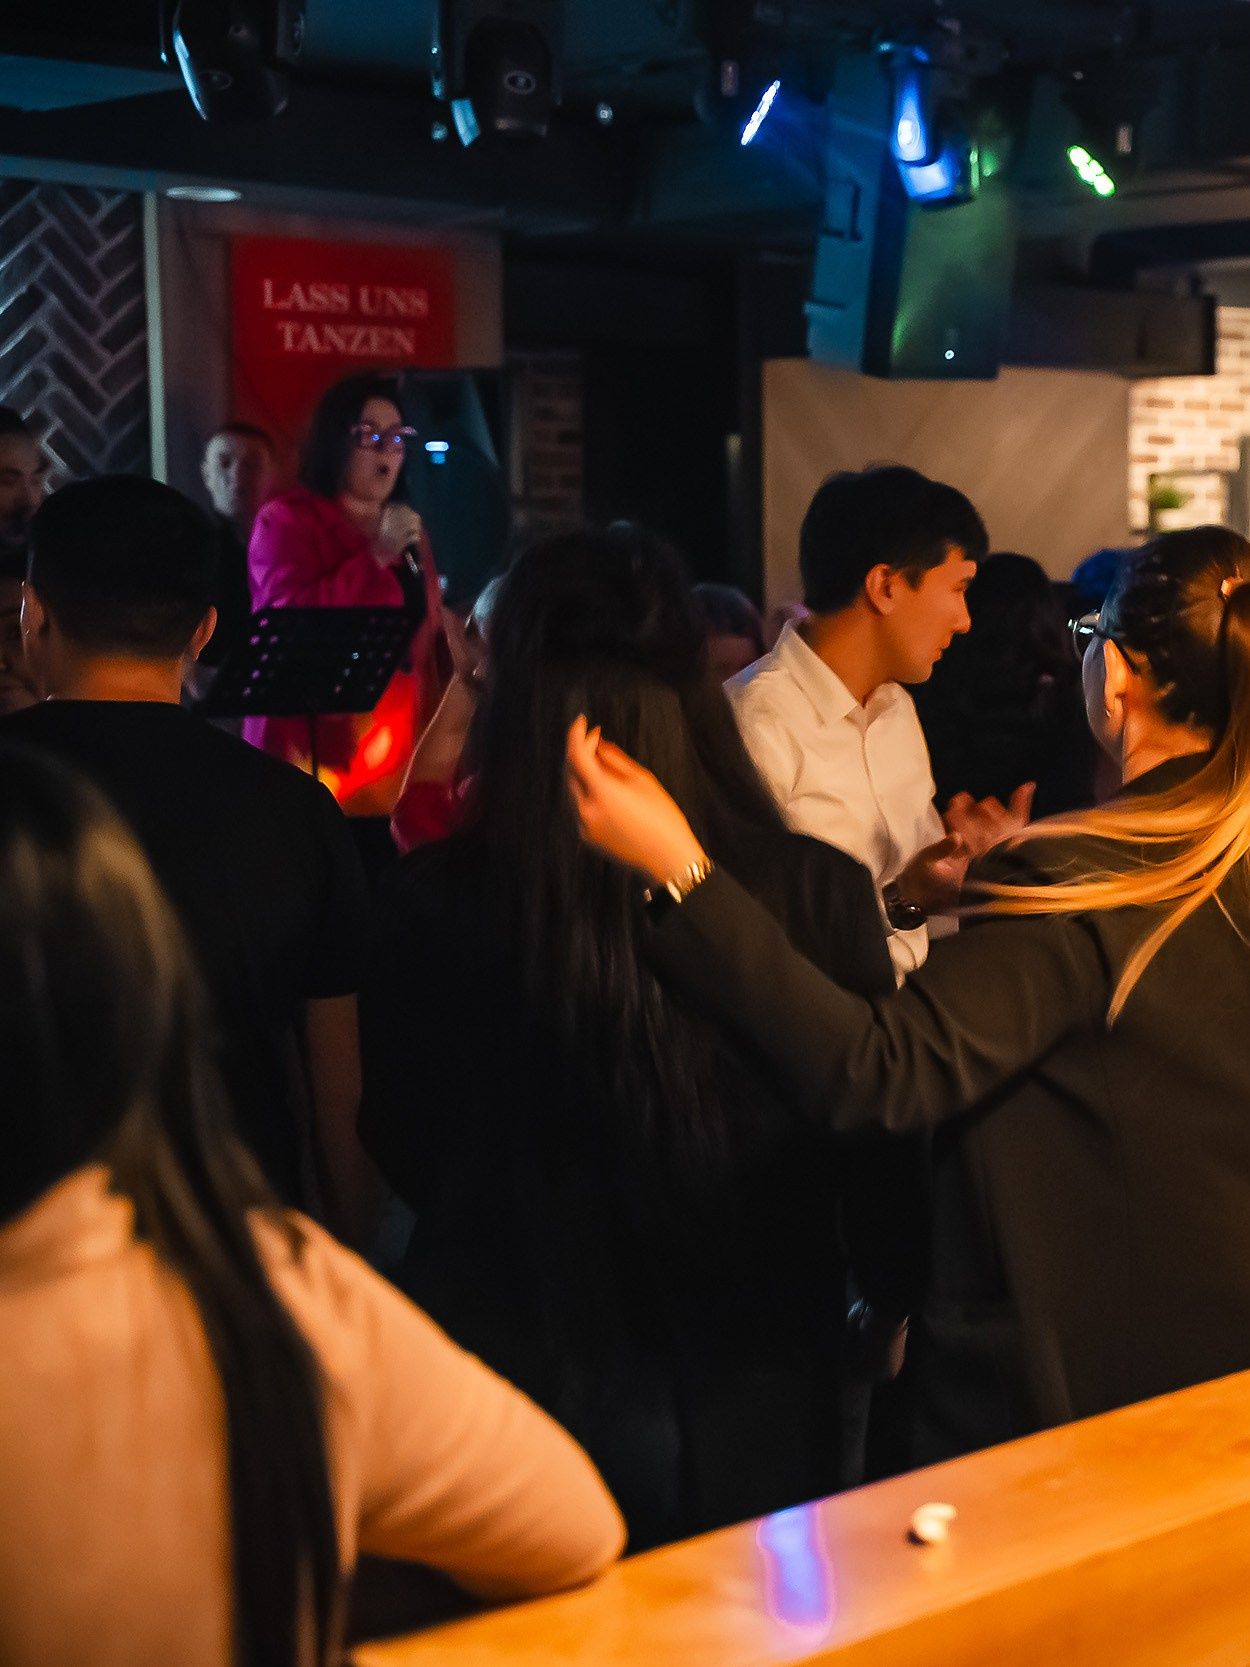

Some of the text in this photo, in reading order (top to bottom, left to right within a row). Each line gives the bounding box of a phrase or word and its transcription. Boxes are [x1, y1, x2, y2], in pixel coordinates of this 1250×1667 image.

[263, 278, 428, 319] LASS UNS
[276, 320, 415, 356] TANZEN
